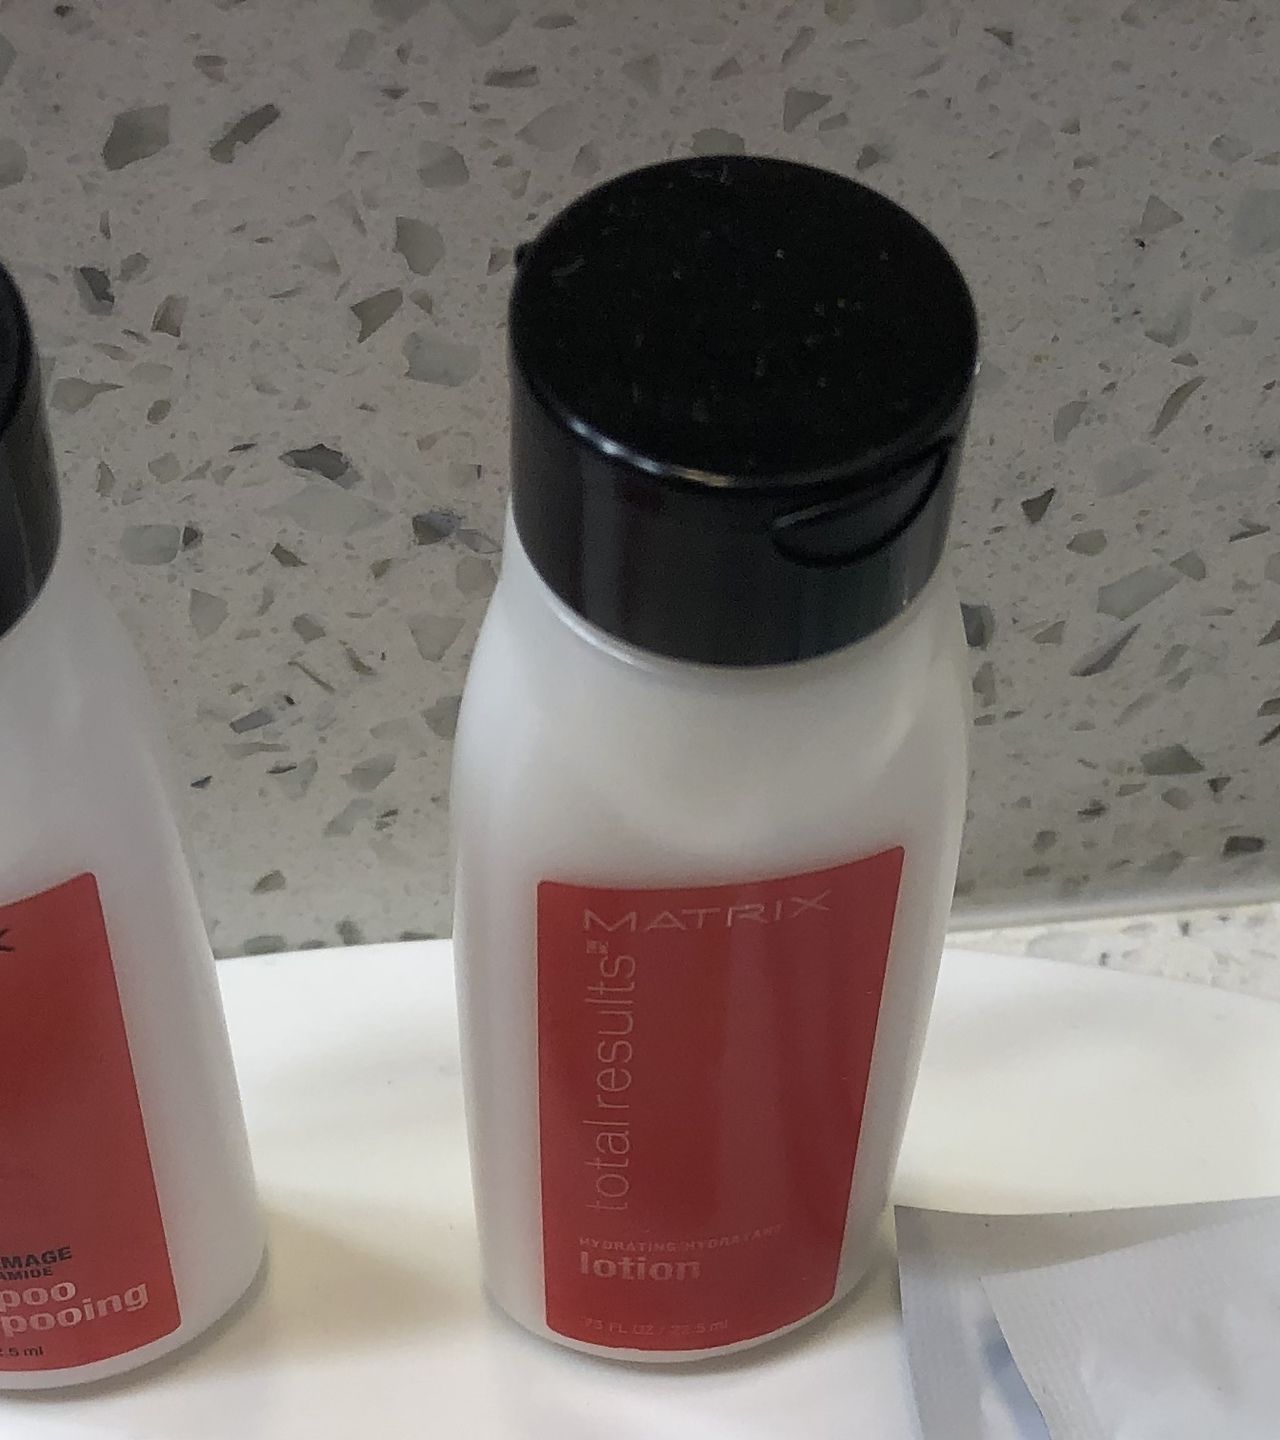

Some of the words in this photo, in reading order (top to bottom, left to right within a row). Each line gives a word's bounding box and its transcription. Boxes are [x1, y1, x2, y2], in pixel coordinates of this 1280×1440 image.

[582, 890, 832, 934] MATRIX
[583, 1120, 629, 1212] total
[579, 1251, 701, 1281] lotion
